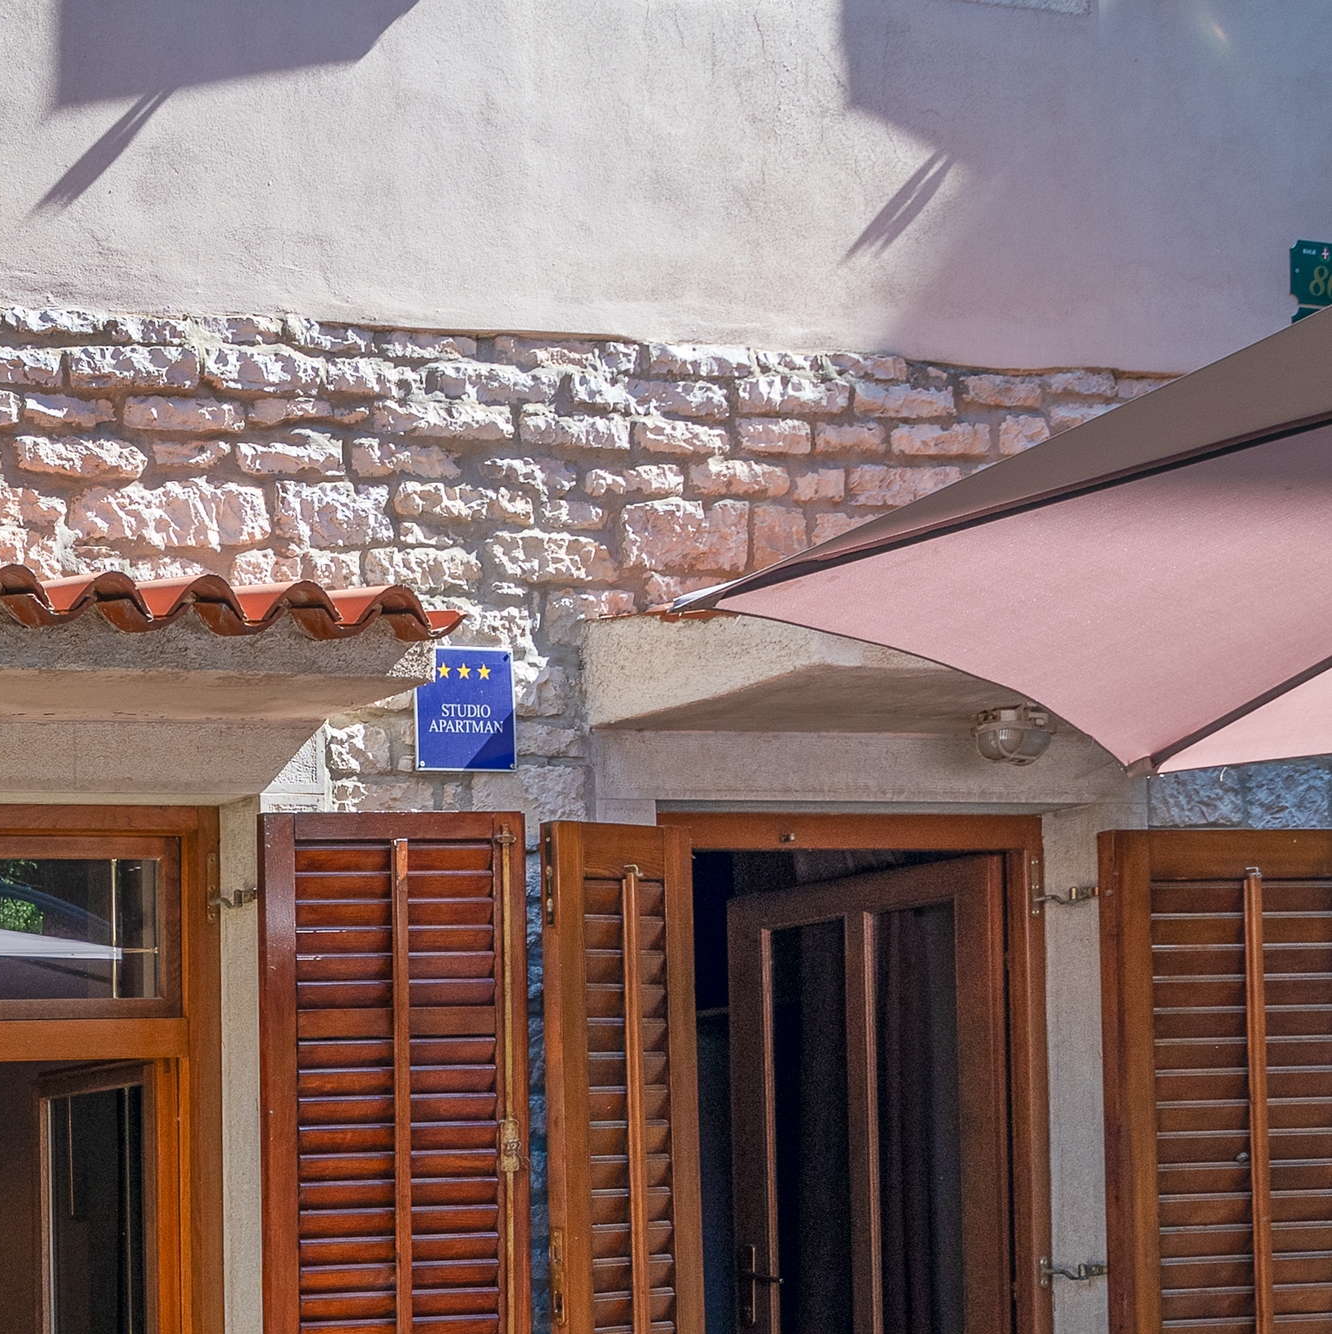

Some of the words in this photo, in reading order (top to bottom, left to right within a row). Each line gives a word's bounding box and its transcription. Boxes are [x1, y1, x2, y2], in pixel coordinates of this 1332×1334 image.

[1309, 265, 1332, 300] 8
[441, 703, 491, 718] STUDIO
[428, 719, 504, 734] APARTMAN
